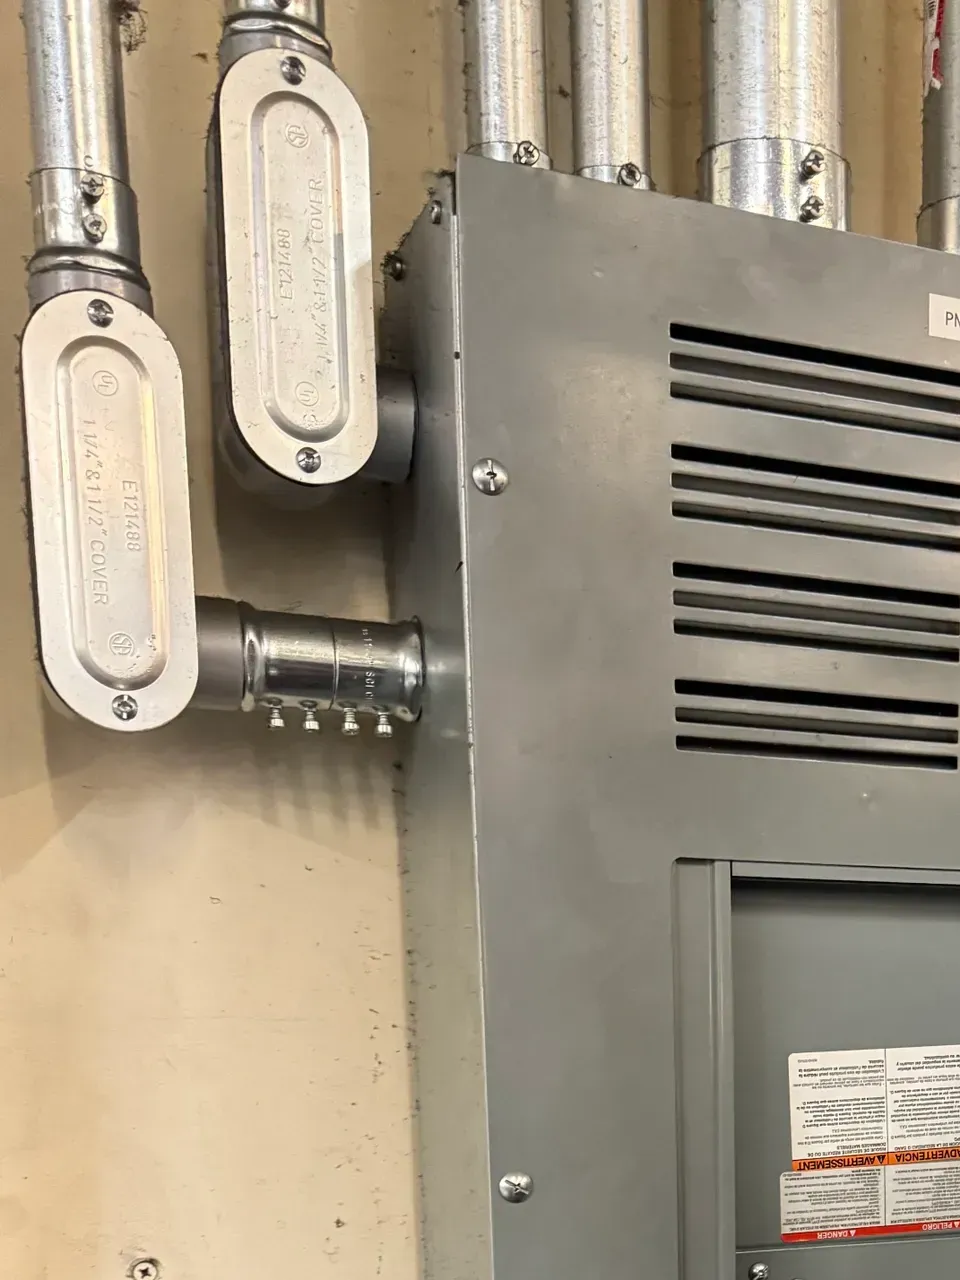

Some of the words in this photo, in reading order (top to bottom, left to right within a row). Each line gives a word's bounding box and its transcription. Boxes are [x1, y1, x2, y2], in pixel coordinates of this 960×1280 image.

[307, 178, 324, 244] COVER
[276, 229, 294, 301] E121488
[122, 480, 142, 552] E121488
[90, 538, 108, 606] COVER
[797, 1155, 878, 1171] AVERTISSEMENT
[816, 1229, 848, 1240] DANGER
[922, 1221, 953, 1231] PELIGRO
